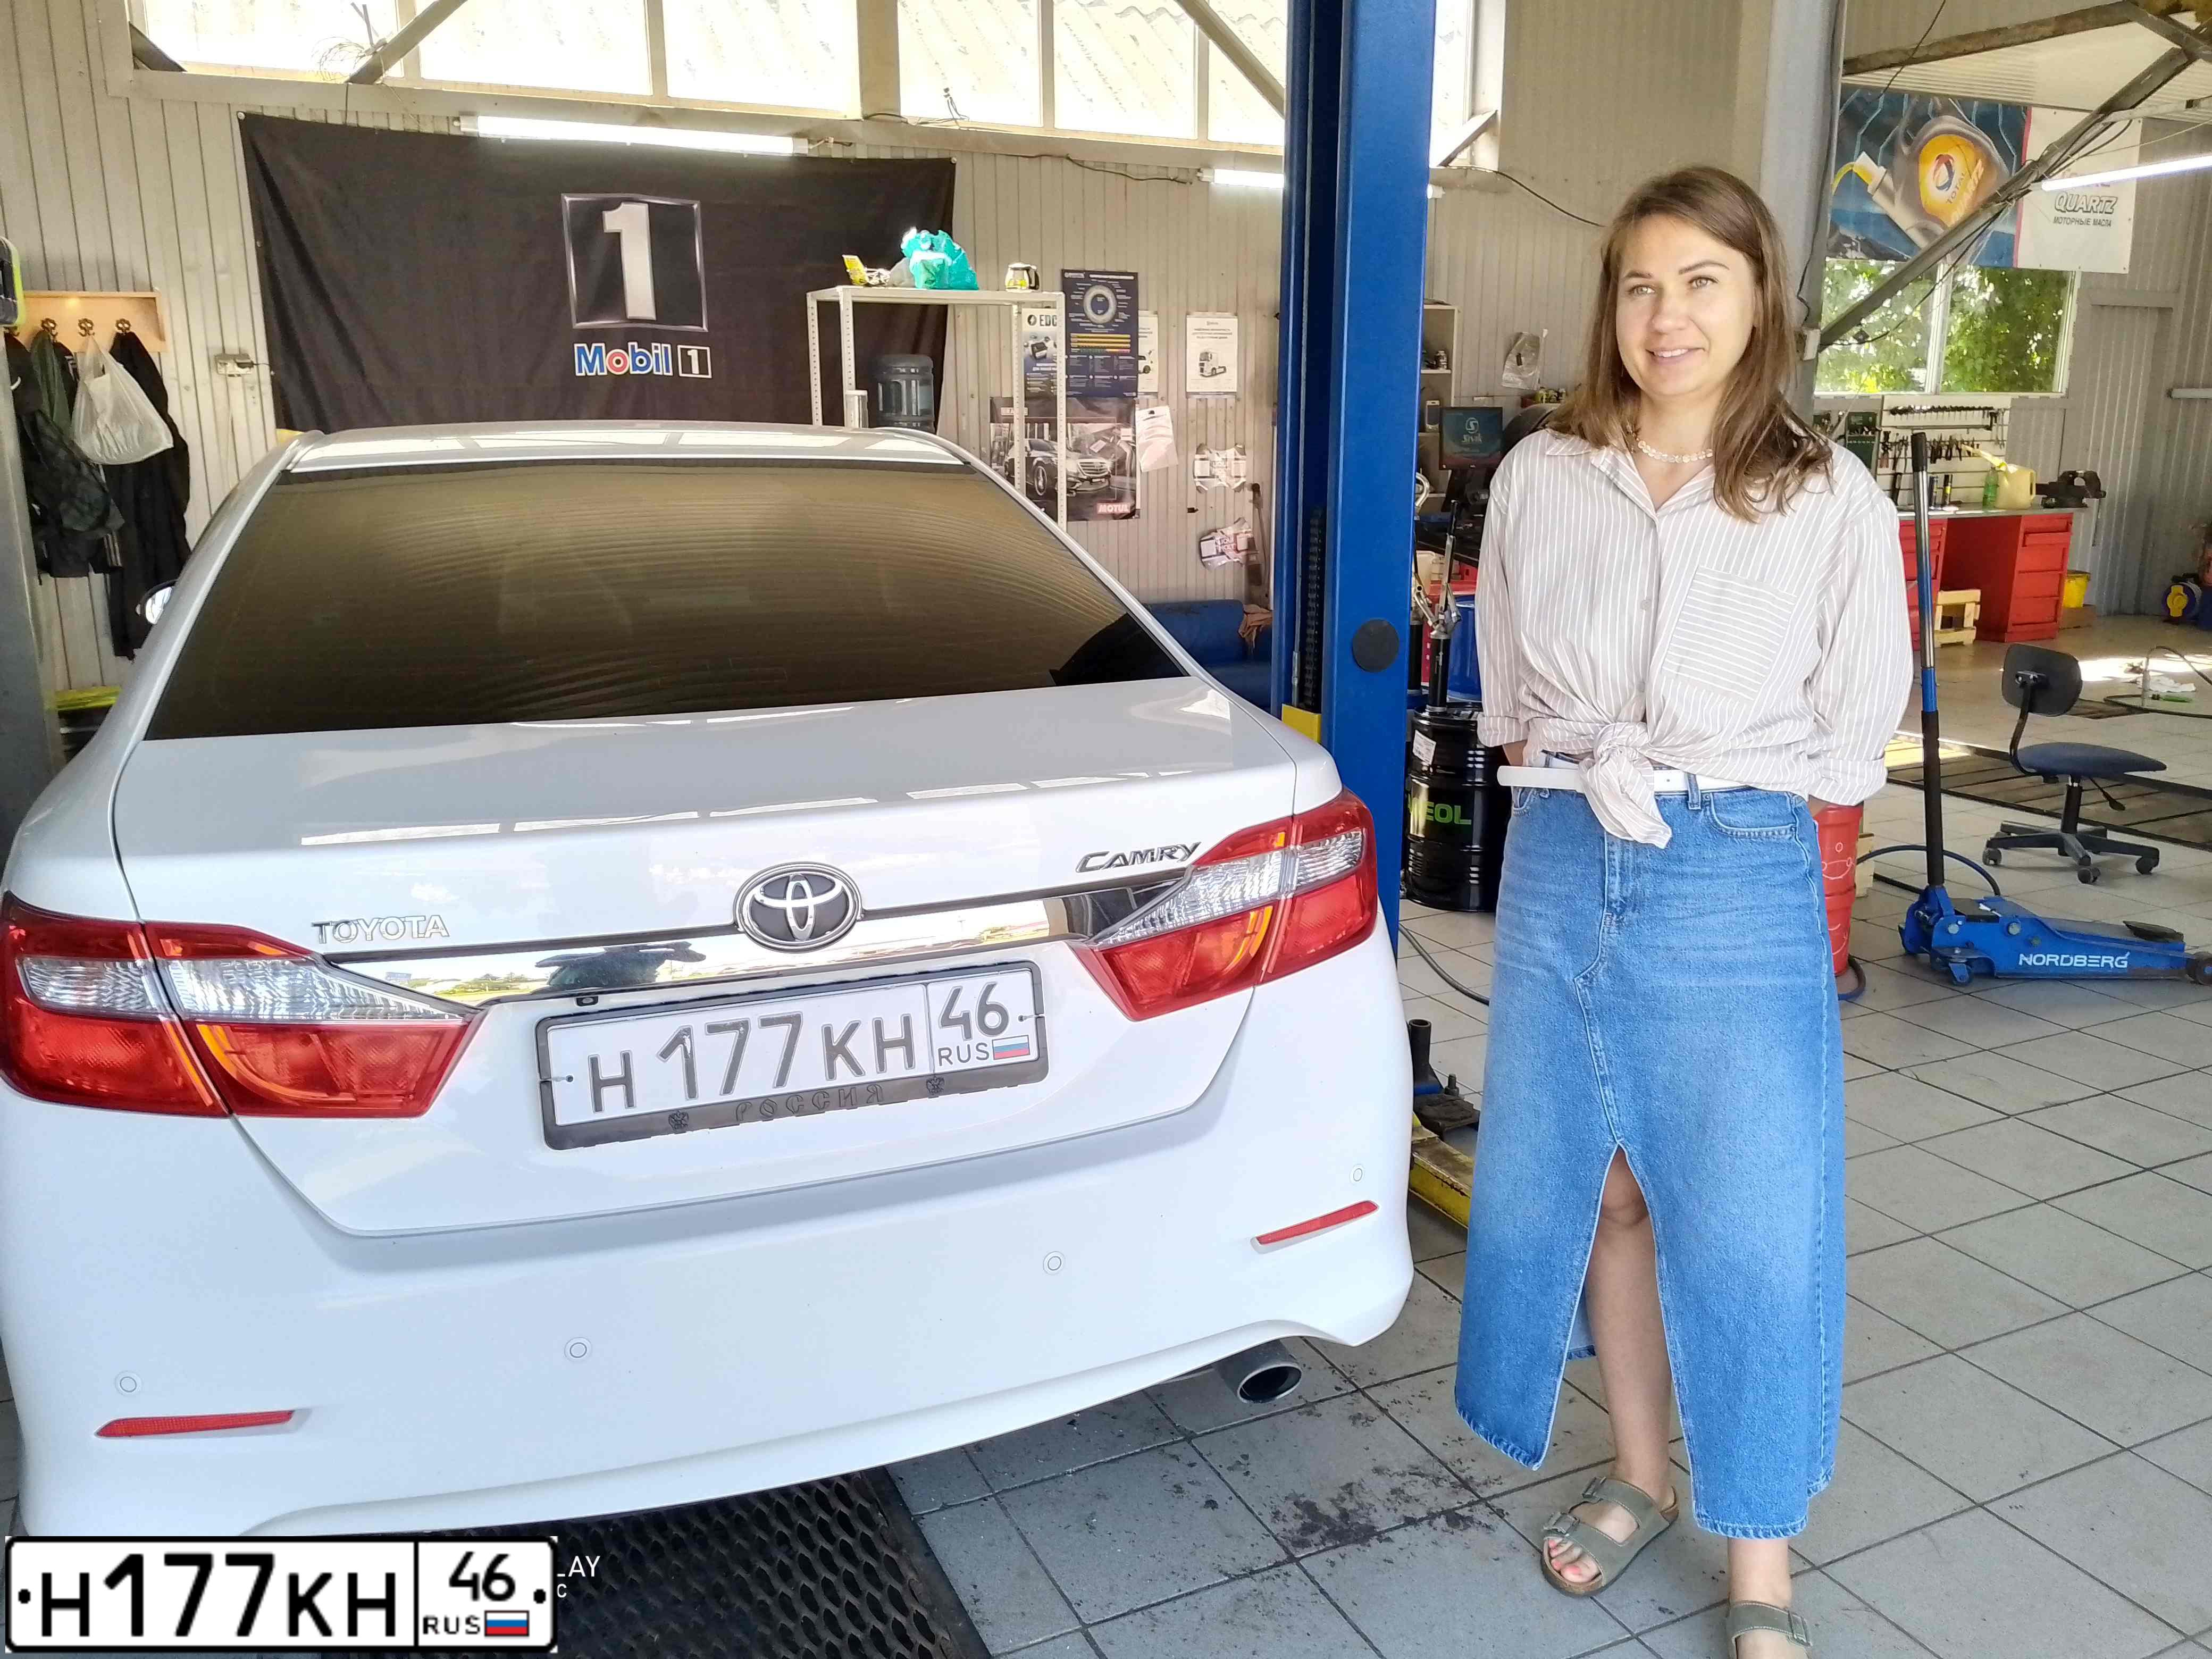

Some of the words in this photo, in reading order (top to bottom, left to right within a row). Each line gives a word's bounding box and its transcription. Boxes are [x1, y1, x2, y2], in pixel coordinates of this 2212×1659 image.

[2055, 191, 2118, 214] QUARTZ
[2054, 216, 2091, 225] МОТОРНЫЕ
[2092, 218, 2112, 227] МАСЛА
[602, 203, 657, 320] 1
[574, 341, 673, 376] Mobil
[1099, 504, 1128, 513] MOTUL
[1076, 841, 1201, 873] CAMRY
[312, 915, 450, 944] TOYOTA
[2018, 952, 2130, 968] NORDBERG
[939, 981, 1009, 1041] 46
[938, 1042, 989, 1066] RUS
[736, 1084, 884, 1121] РОССИЯ
